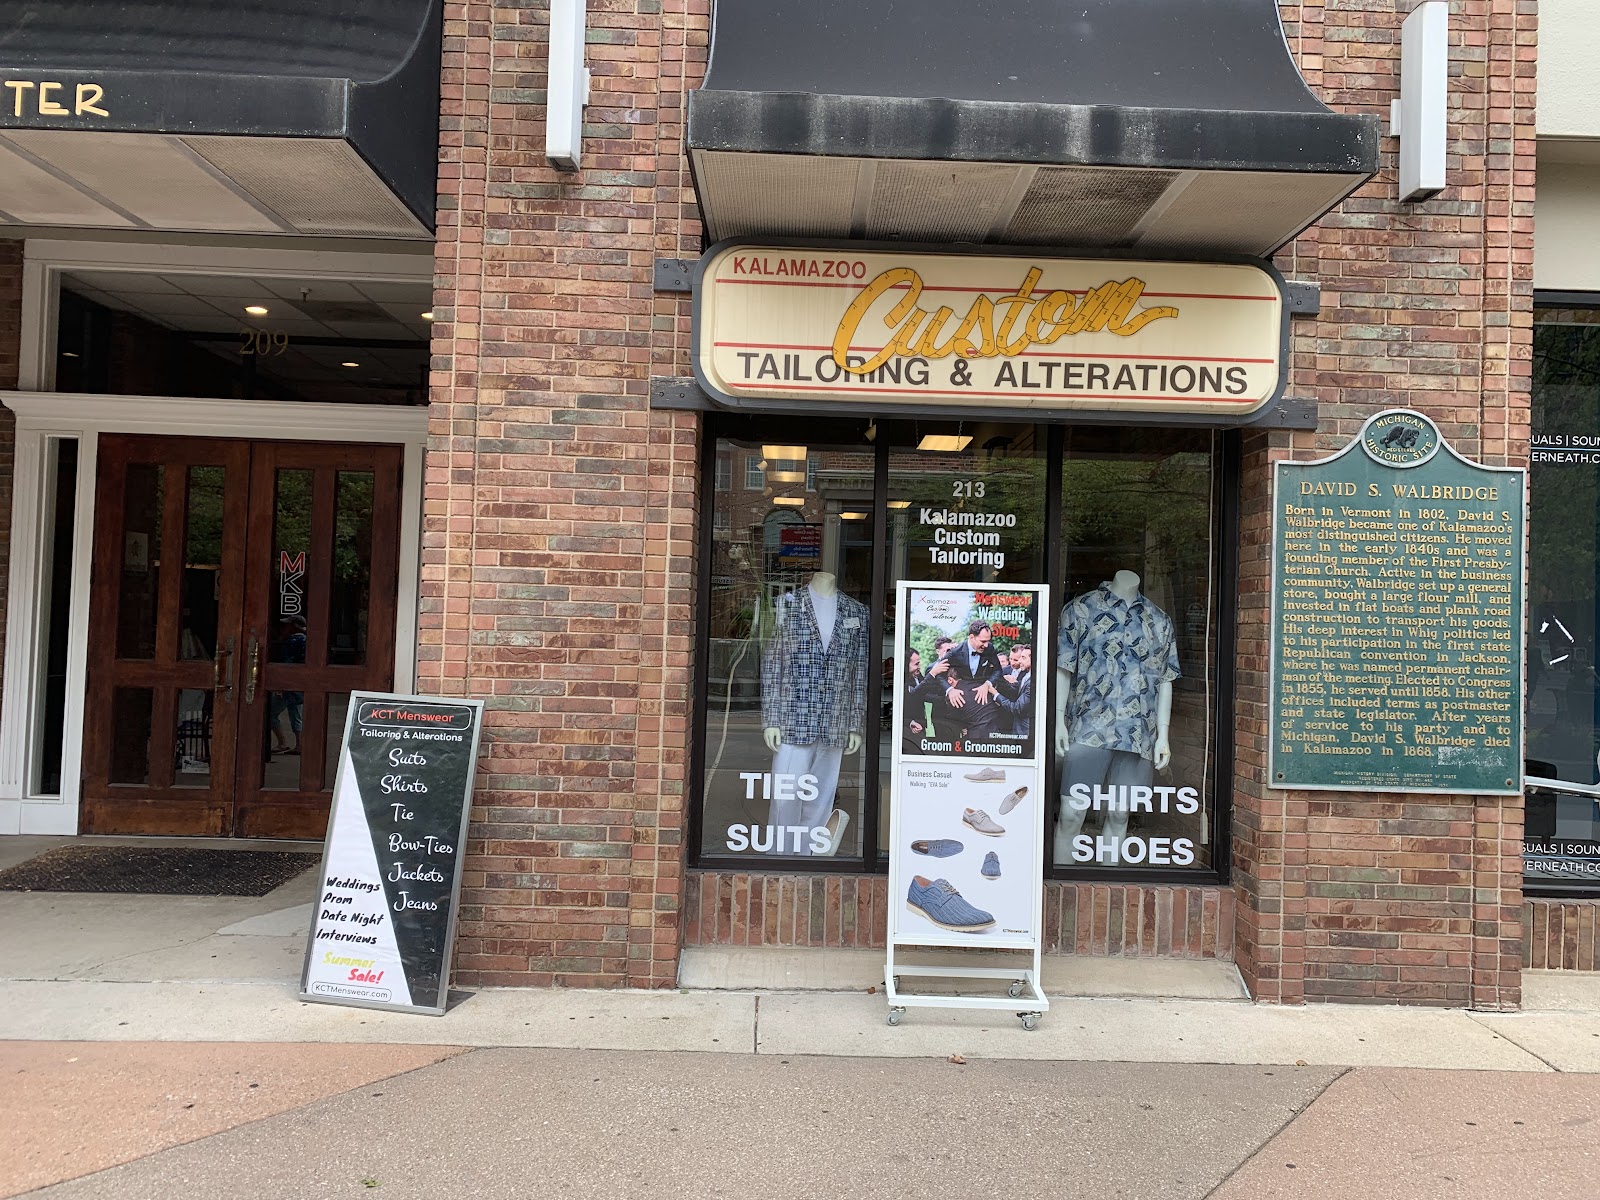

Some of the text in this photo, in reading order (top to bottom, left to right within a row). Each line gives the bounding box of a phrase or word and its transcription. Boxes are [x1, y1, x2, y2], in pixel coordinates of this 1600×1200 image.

[5, 81, 109, 117] TER
[733, 257, 867, 280] KALAMAZOO
[832, 266, 1179, 375] Custom
[239, 327, 289, 356] 209
[953, 360, 973, 387] &
[994, 361, 1249, 396] ALTERATIONS
[1375, 415, 1426, 429] MICHIGAN
[1529, 434, 1563, 445] UALS
[1367, 438, 1433, 462] HISTORIC SITE
[1528, 451, 1600, 464] ERNEATH.C
[952, 481, 985, 498] 213
[1301, 481, 1498, 501] DAVID S. WALBRIDGE
[920, 508, 1016, 527] Kalamazoo
[1285, 505, 1315, 516] Born
[1322, 506, 1333, 516] in
[1342, 506, 1391, 518] Vermont
[1399, 508, 1410, 518] in
[1458, 509, 1494, 520] David
[1501, 510, 1512, 521] S.
[1286, 517, 1512, 532] Walbridge became one of Kalamazoo's
[934, 527, 1000, 546] Custom
[1284, 529, 1511, 544] most distinguished citizens. He moved
[929, 547, 1005, 569] Tailoring
[1284, 552, 1338, 566] founding
[1341, 554, 1389, 565] member
[1392, 555, 1404, 565] of
[1408, 555, 1427, 566] the
[1431, 556, 1461, 567] First
[1284, 564, 1511, 580] terian Church. Active in the business
[1356, 578, 1415, 592] Walbridge
[1418, 579, 1436, 590] set
[1439, 582, 1455, 593] up
[1458, 583, 1464, 591] a
[1467, 581, 1511, 594] general
[975, 592, 1031, 606] Menswear
[1324, 589, 1366, 602] bought
[1382, 590, 1412, 603] large
[1417, 591, 1449, 602] flour
[1488, 593, 1511, 604] and
[978, 606, 1025, 624] Wedding
[1283, 600, 1511, 617] invested in flat boats and plank road
[1282, 612, 1510, 630] construction to transport his goods.
[992, 623, 1019, 640] Shop
[1283, 624, 1510, 641] His deep interest in Whig politics led
[1282, 647, 1351, 661] Republican
[1360, 649, 1427, 661] convention
[1436, 651, 1448, 662] in
[1282, 659, 1317, 670] where
[1321, 660, 1335, 671] he
[1339, 663, 1359, 671] was
[1363, 661, 1402, 672] named
[1406, 662, 1470, 676] permanent
[1281, 695, 1510, 713] offices included terms as postmaster
[371, 709, 455, 723] KCT Menswear
[1280, 707, 1510, 725] and state legislator. After years
[360, 728, 463, 742] Tailoring & Alterations
[1350, 732, 1386, 743] David
[1395, 733, 1405, 744] S.
[1414, 734, 1475, 748] Walbridge
[1484, 735, 1510, 746] died
[920, 739, 1022, 754] Groom & Groomsmen
[1280, 742, 1434, 756] in Kalamazoo in 1868.
[388, 748, 427, 767] Suits
[907, 769, 952, 779] Business Casual
[380, 774, 428, 794] Shirts
[739, 772, 819, 801] TIES
[1068, 783, 1199, 814] SHIRTS
[390, 803, 415, 822] Tie
[388, 832, 453, 855] Bow-Ties
[726, 823, 832, 854] SUITS
[1071, 834, 1195, 865] SHOES
[388, 861, 444, 883] Jackets
[1523, 861, 1600, 873] ERNEATH.CO
[326, 877, 381, 893] Weddings
[323, 892, 353, 905] Prom
[393, 891, 438, 911] Jeans
[320, 909, 385, 927] Date Night
[316, 928, 378, 945] Interviews
[322, 951, 376, 968] Summer
[348, 968, 384, 984] Sale!
[315, 984, 388, 998] KCTMenswear.com
